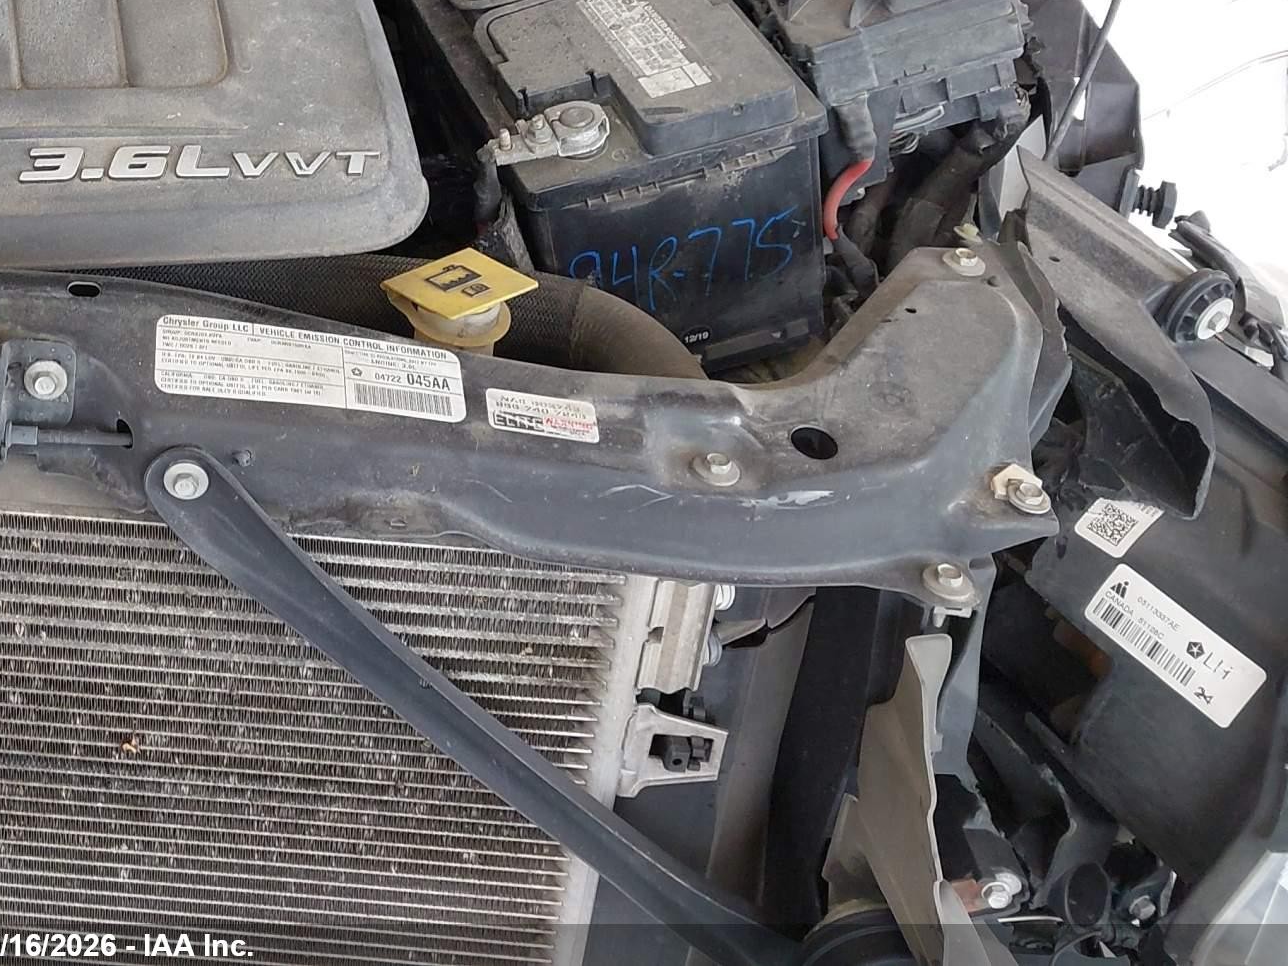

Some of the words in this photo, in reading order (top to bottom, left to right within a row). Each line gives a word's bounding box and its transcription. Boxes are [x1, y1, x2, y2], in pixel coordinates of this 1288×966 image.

[18, 144, 230, 183] 3.6L
[232, 150, 382, 178] VVT
[162, 316, 199, 327] Chrysler
[202, 320, 229, 331] Group
[232, 323, 249, 333] LLC
[259, 326, 295, 339] VEHICLE
[298, 332, 340, 344] EMISSION
[343, 337, 384, 350] CONTROL
[386, 344, 447, 360] INFORMATION
[684, 330, 709, 344] 12/19
[374, 372, 402, 383] 04722
[406, 373, 451, 391] 045AA
[1105, 590, 1134, 616] CANADA
